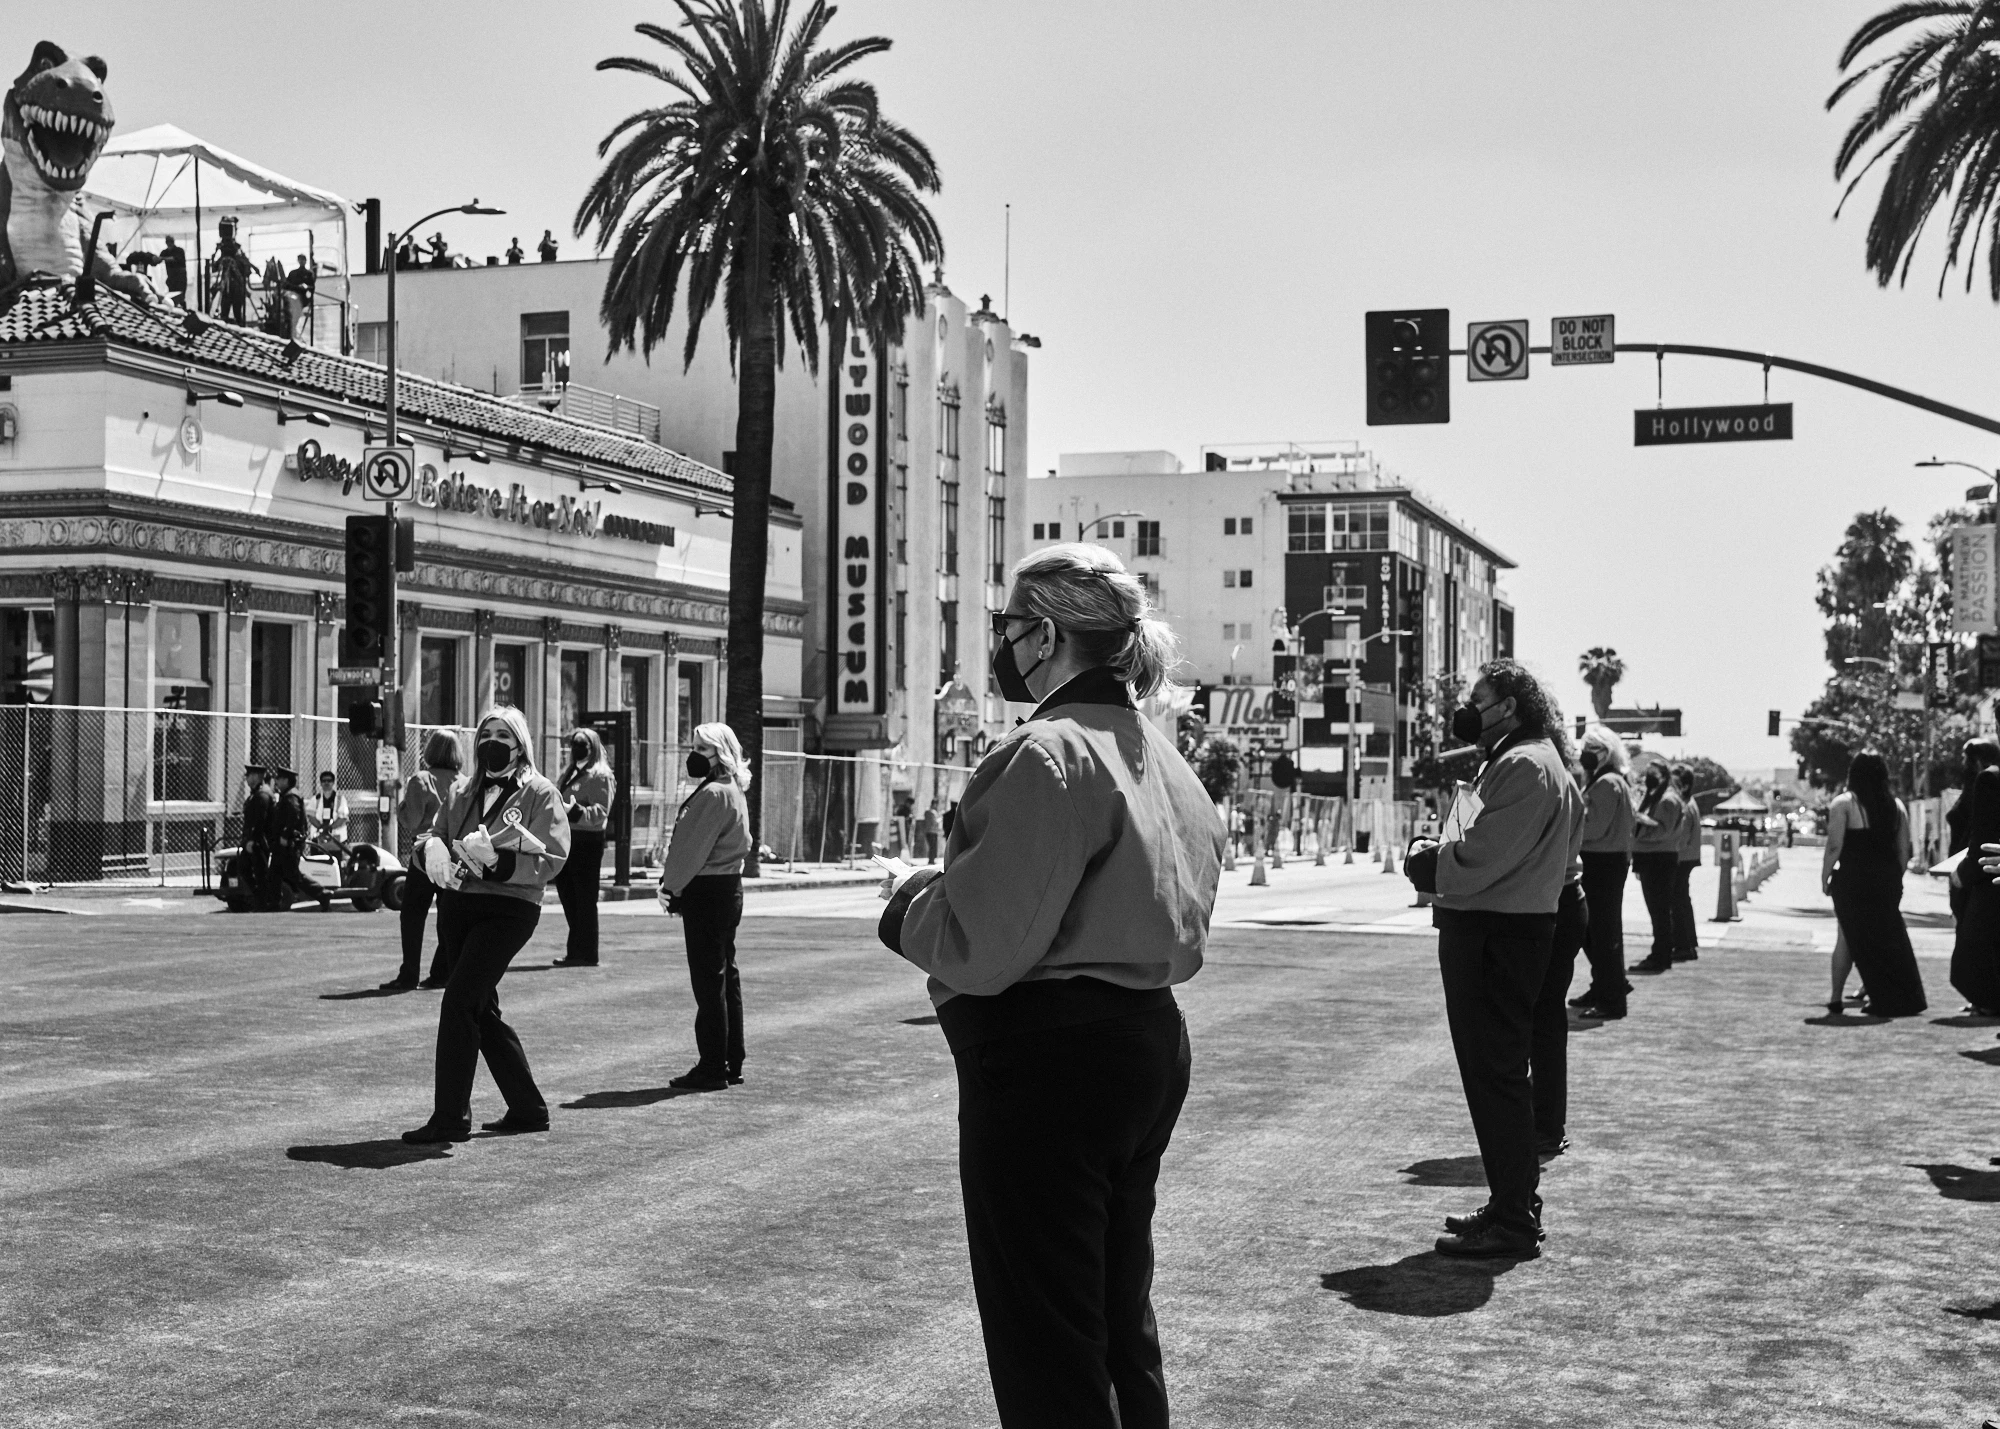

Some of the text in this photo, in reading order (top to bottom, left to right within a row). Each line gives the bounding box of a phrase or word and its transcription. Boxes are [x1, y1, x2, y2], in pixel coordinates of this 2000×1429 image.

[1559, 318, 1606, 335] DO NOT
[1562, 335, 1603, 350] BLOCK
[1555, 351, 1612, 362] INTERSECTION
[1652, 413, 1775, 438] Hollywood
[1971, 534, 1988, 623] PASSION
[1380, 556, 1391, 643] NOW LEASING
[844, 536, 870, 703] MUSEUM
